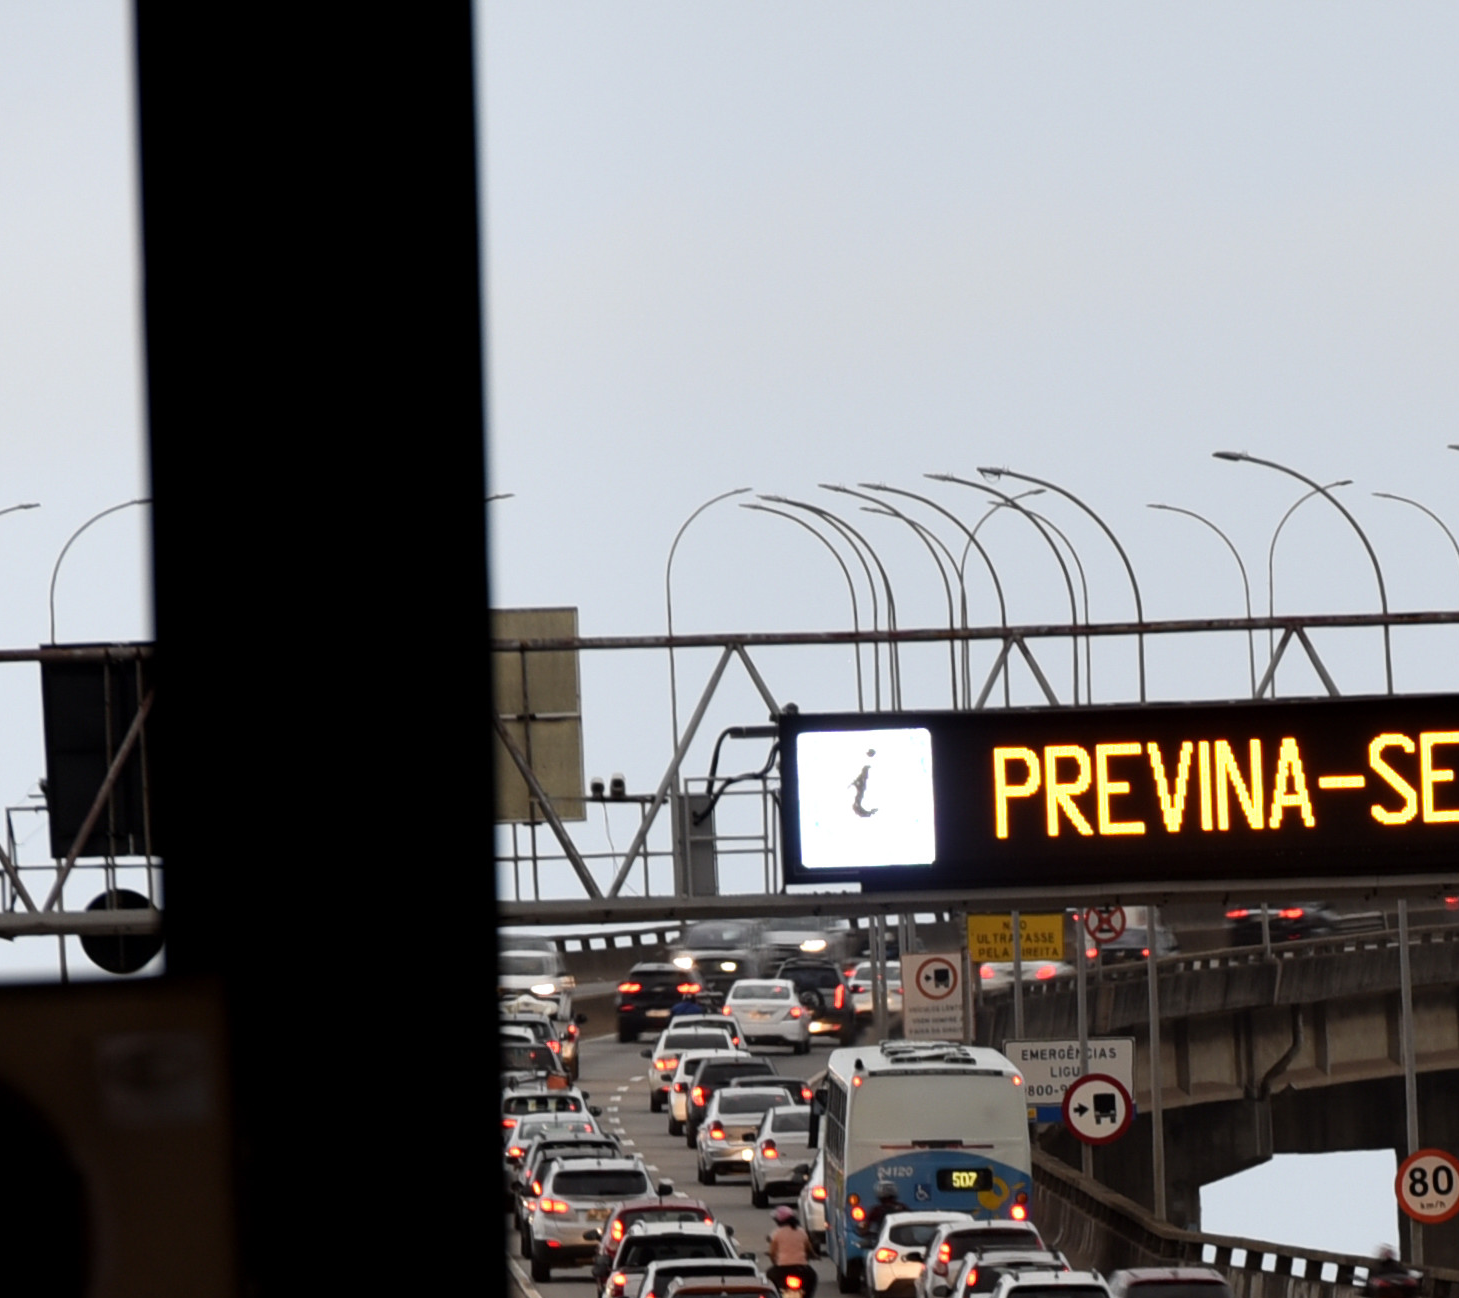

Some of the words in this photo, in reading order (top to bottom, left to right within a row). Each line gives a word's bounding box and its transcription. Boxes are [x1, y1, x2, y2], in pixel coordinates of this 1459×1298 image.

[1002, 919, 1027, 930] NO
[978, 947, 1010, 958] PELA
[1020, 946, 1060, 958] IREITA
[1050, 1066, 1081, 1078] LIGU
[951, 1171, 978, 1188] 507
[1408, 1164, 1454, 1197] 80
[1420, 1200, 1446, 1210] km/h
